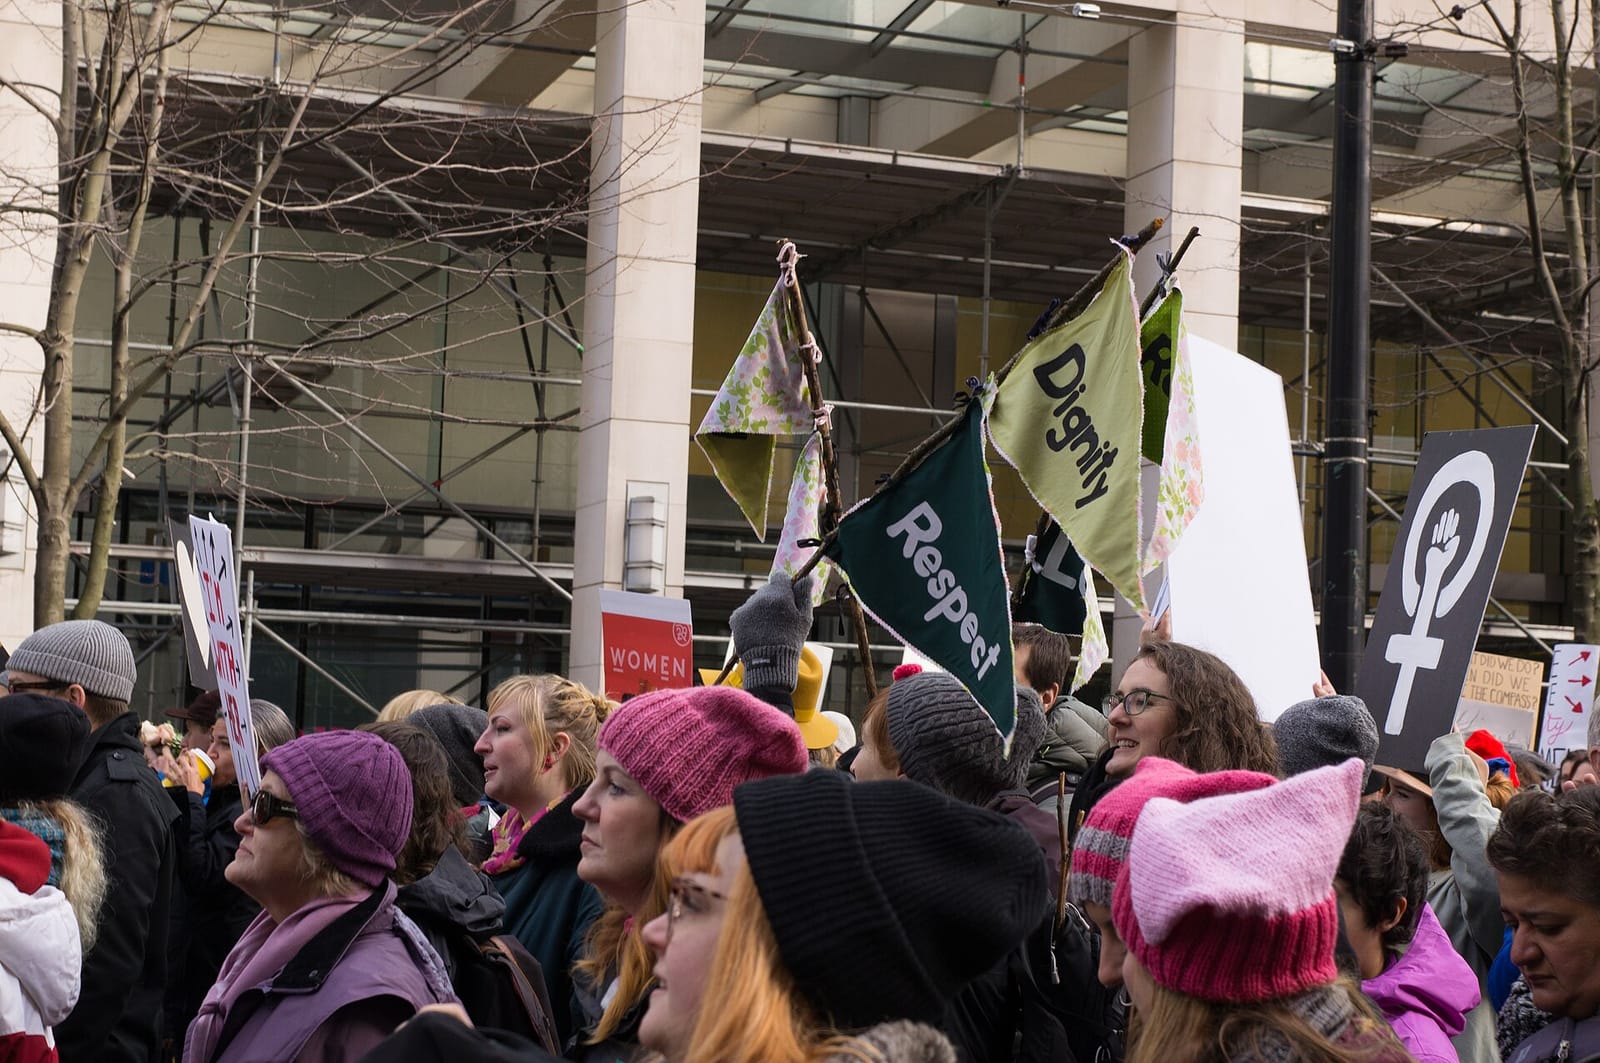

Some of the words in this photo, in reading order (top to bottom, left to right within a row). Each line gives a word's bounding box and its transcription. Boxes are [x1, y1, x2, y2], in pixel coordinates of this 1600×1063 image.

[1033, 343, 1118, 509] Dignity
[886, 501, 1000, 681] Respect
[212, 634, 238, 689] WITH
[610, 646, 686, 680] WOMEN
[1480, 654, 1496, 669] DID
[1497, 656, 1514, 672] WE
[1483, 670, 1504, 686] DID
[1510, 675, 1531, 692] WE
[1489, 688, 1538, 710] COMPASS?
